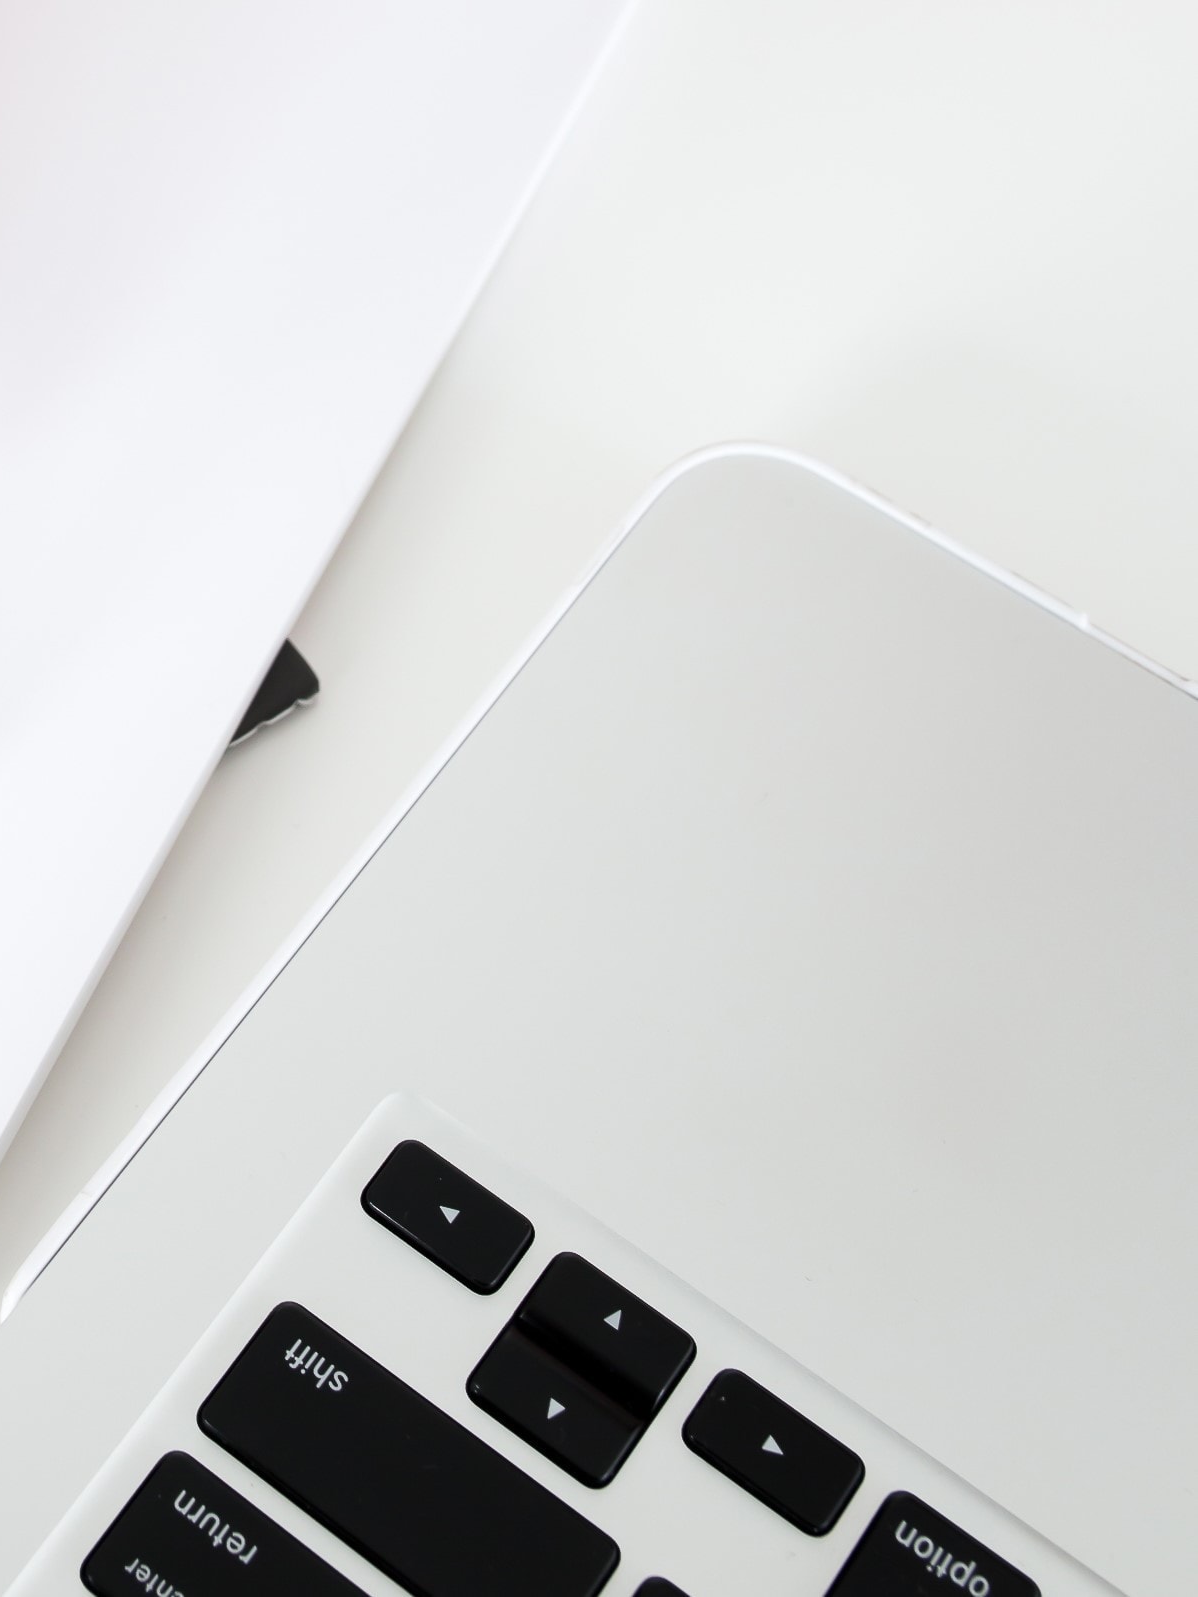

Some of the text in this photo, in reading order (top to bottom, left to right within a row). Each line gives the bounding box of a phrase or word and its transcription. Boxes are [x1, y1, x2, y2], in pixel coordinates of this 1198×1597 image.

[284, 1338, 349, 1392] shift
[173, 1489, 258, 1565] return
[895, 1520, 990, 1597] option
